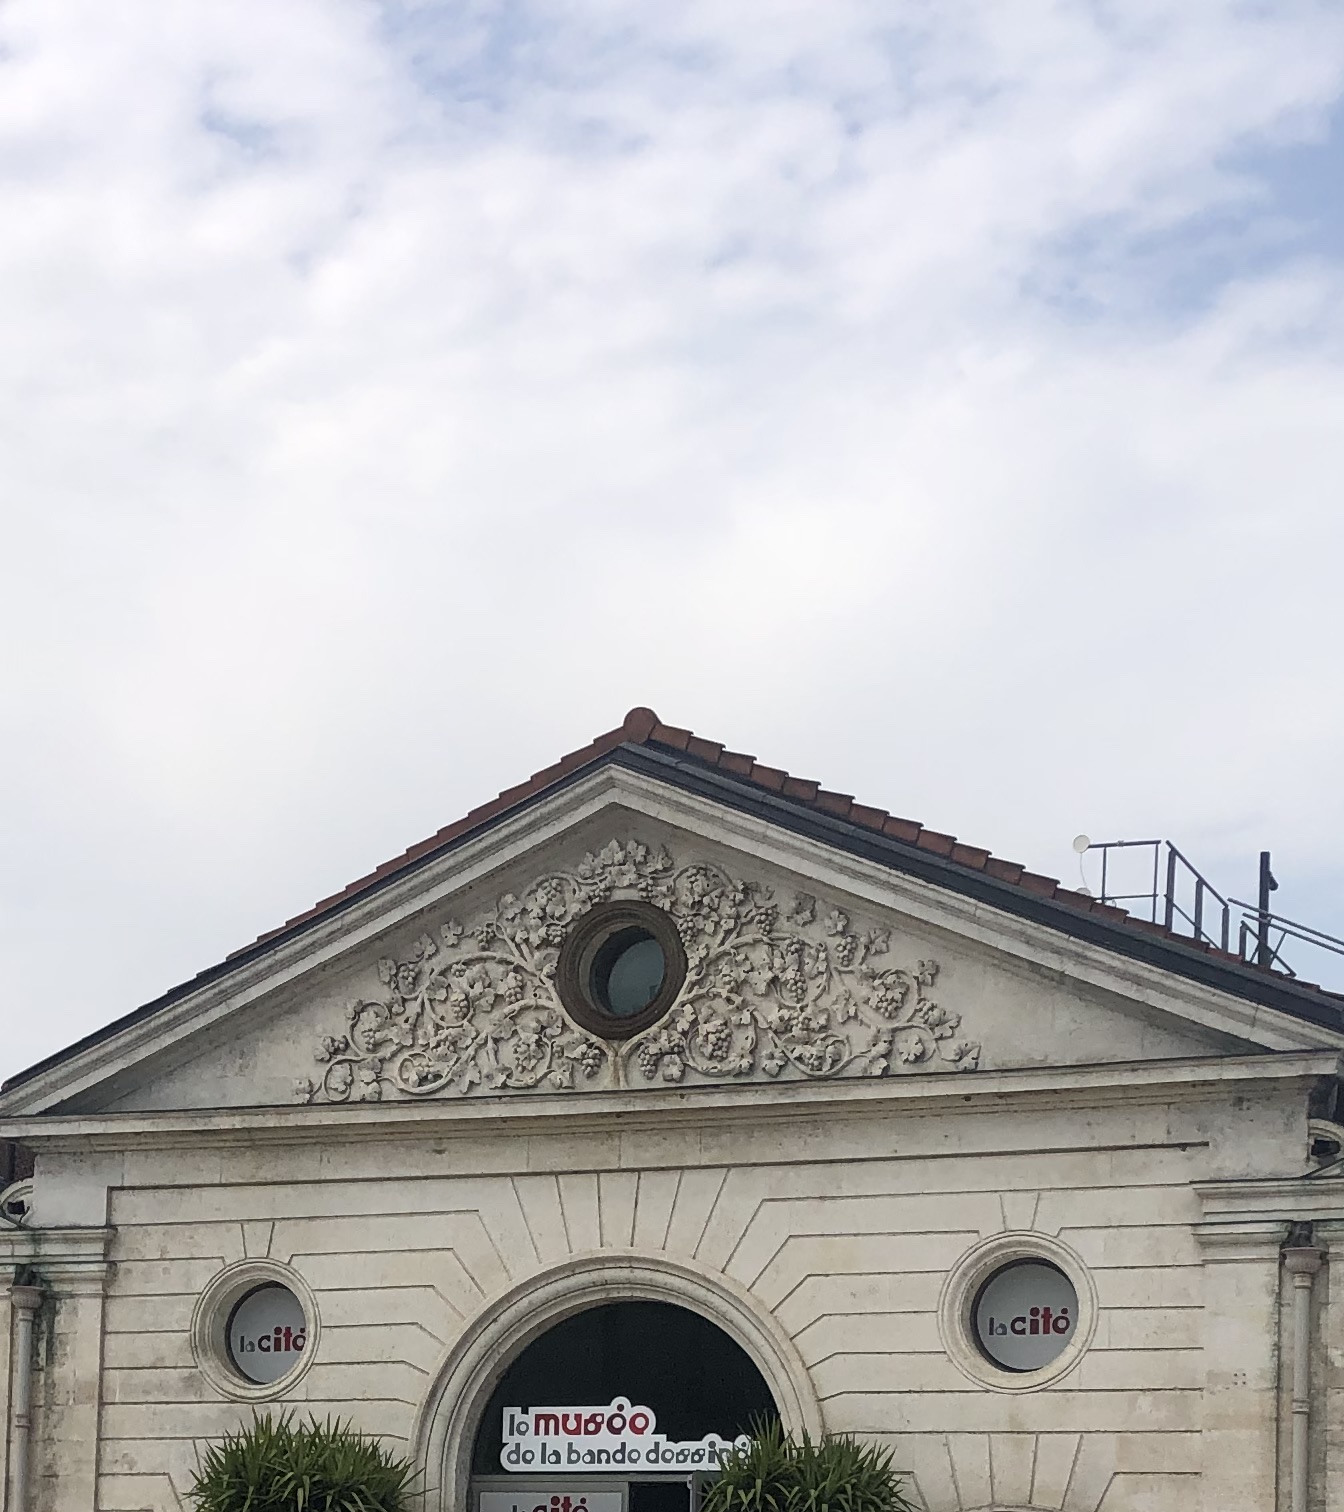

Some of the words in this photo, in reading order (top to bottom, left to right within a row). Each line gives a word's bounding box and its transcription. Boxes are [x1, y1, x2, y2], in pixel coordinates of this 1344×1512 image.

[989, 1317, 1008, 1336] la
[1011, 1307, 1071, 1336] cité
[239, 1336, 256, 1353] la
[257, 1326, 307, 1353] cité
[508, 1413, 530, 1436] le
[533, 1403, 650, 1436] musée
[506, 1441, 535, 1465] de
[540, 1441, 562, 1465] la
[566, 1441, 642, 1465] bande
